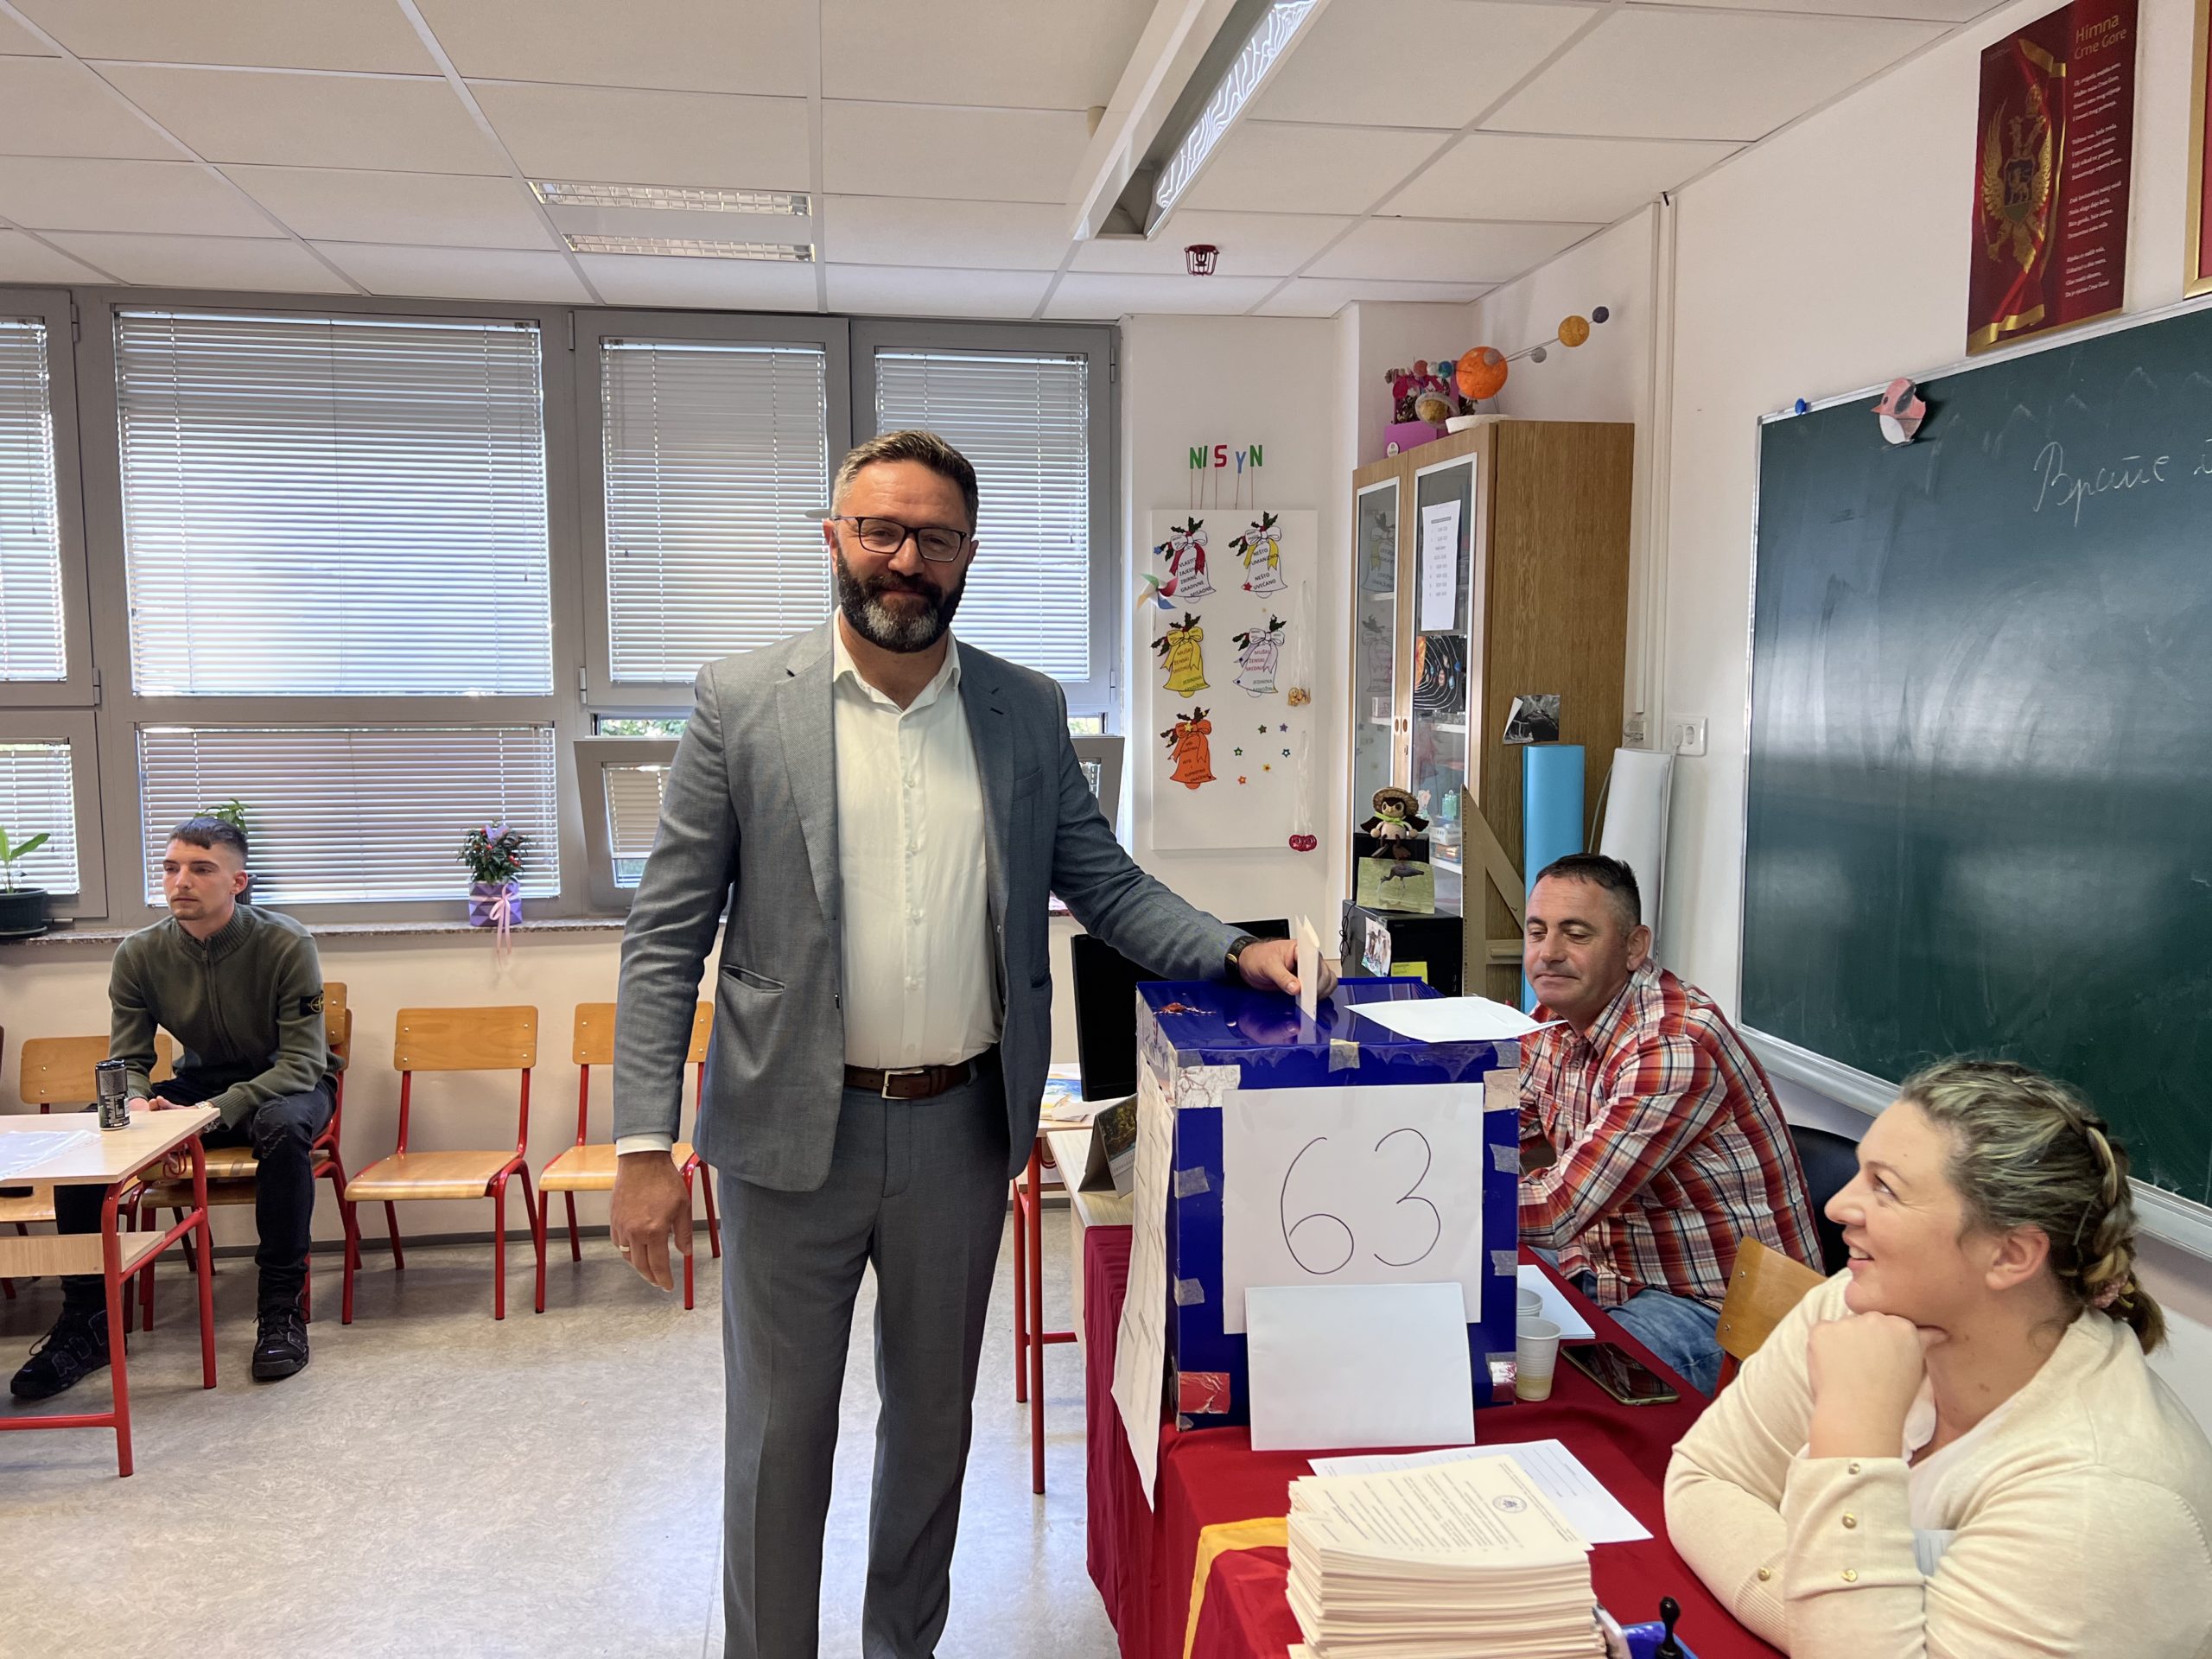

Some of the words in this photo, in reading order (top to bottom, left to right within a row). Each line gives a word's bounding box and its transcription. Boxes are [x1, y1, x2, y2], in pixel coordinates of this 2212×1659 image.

[2075, 15, 2120, 43] Himna
[2074, 41, 2100, 60] Crne
[2101, 29, 2127, 48] Gore
[1179, 557, 1196, 568] VLASTIT
[1179, 567, 1195, 576] ZAJEDN
[1281, 1128, 1440, 1274] 63
